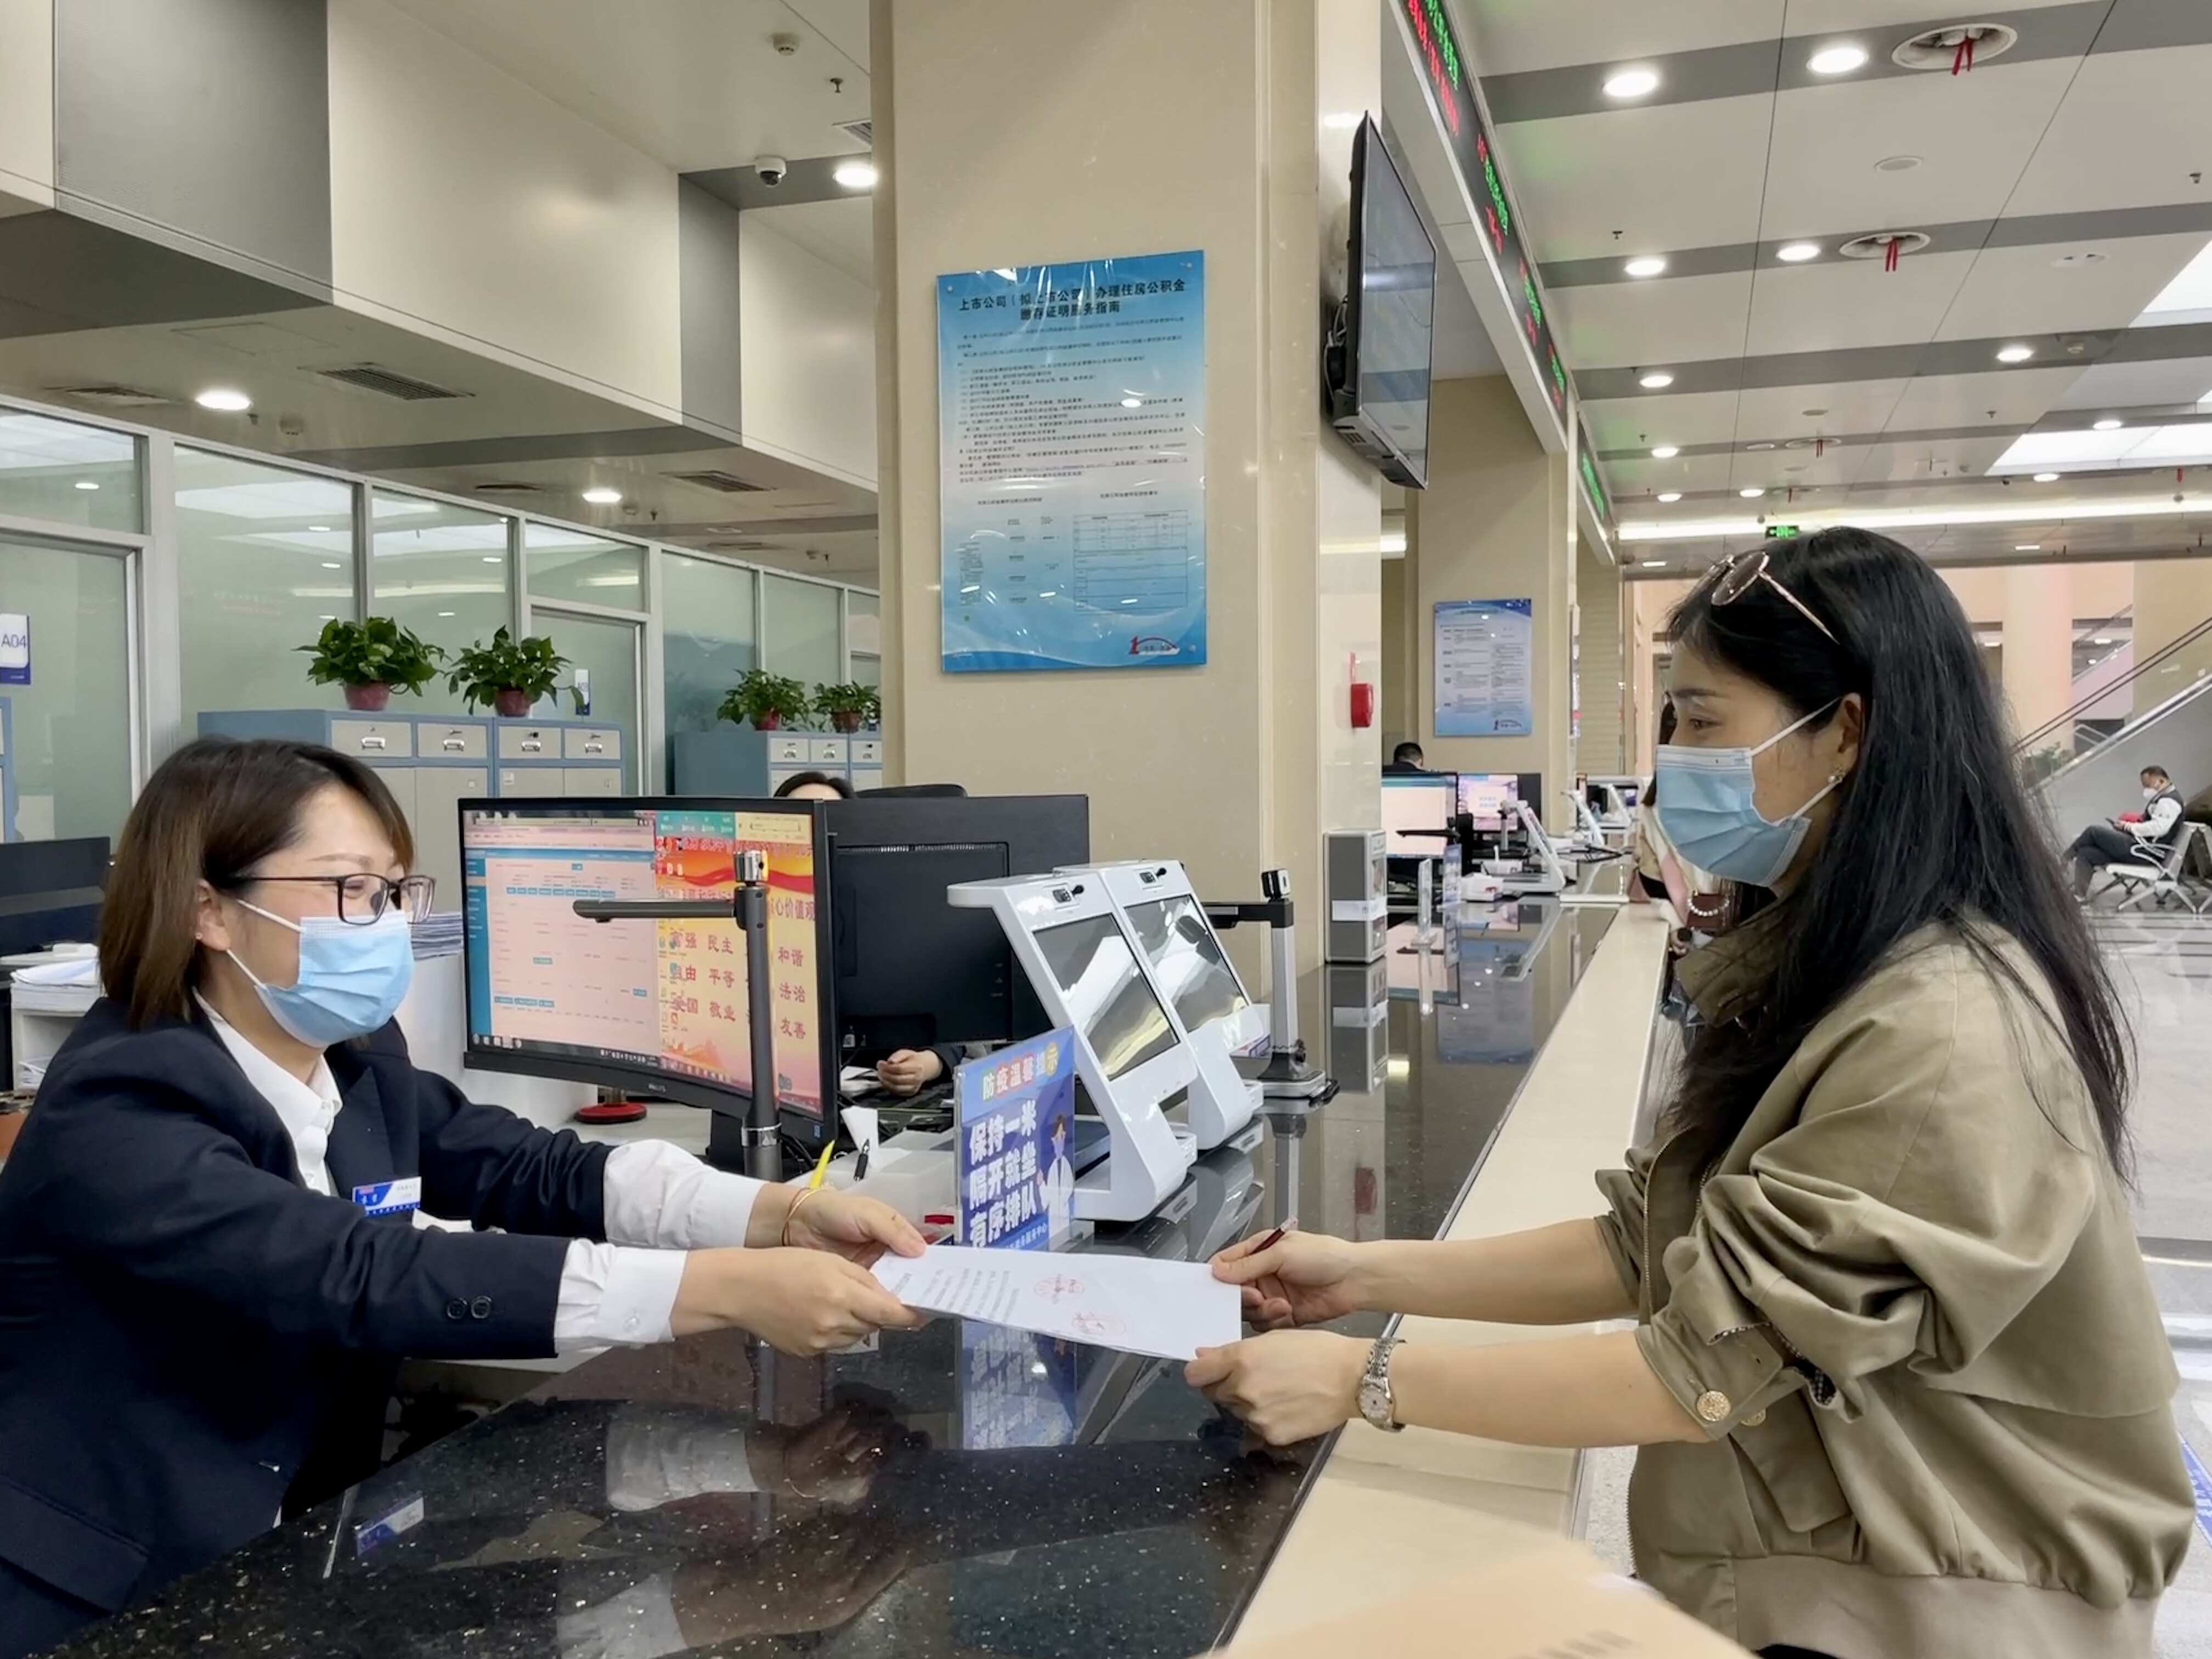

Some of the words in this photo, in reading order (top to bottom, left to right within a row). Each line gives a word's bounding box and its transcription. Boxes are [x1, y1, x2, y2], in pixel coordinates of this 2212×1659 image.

[1, 634, 27, 648] A04
[708, 934, 733, 954] 民主
[777, 946, 804, 967] 和谐
[708, 968, 735, 988] 平等
[778, 982, 806, 1003] 法治
[709, 1001, 736, 1022] 敬业
[780, 1017, 806, 1039] 友善
[969, 1099, 1036, 1165] 保持一米
[969, 1180, 1037, 1248] 有序排队
